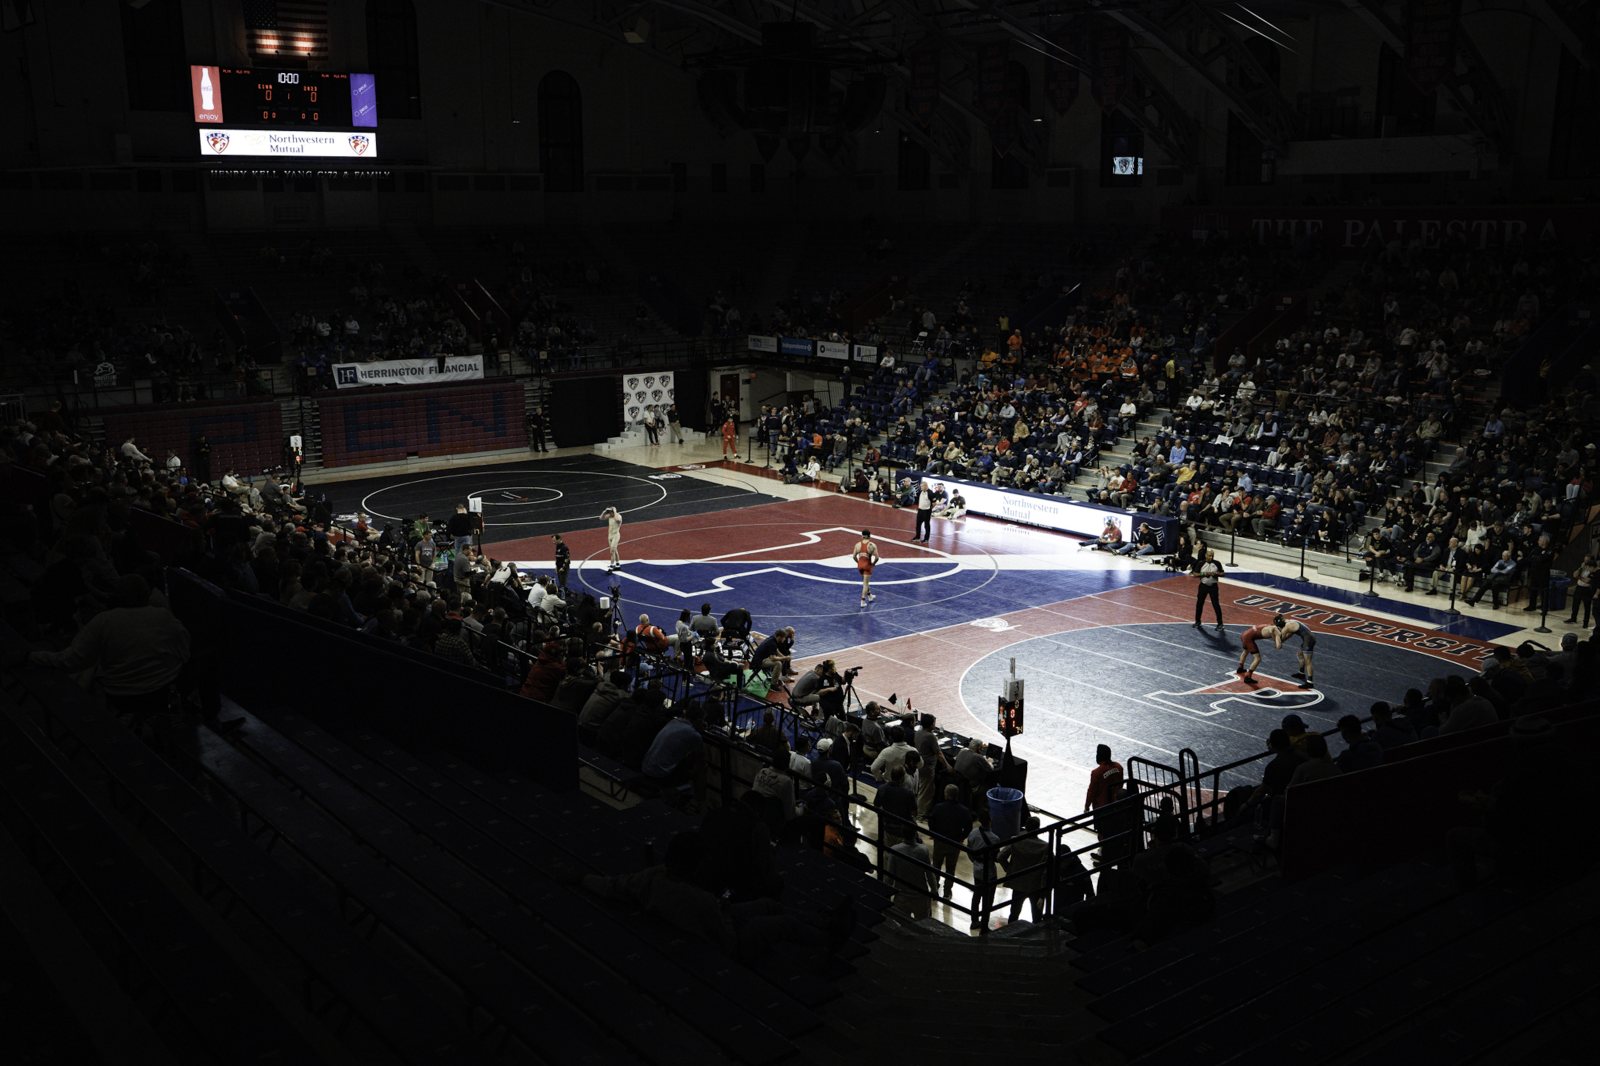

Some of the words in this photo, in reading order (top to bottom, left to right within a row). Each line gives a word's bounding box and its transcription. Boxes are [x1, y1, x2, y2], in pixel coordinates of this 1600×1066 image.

[278, 72, 299, 84] 10:00
[265, 90, 272, 101] 0
[310, 91, 317, 102] 0
[198, 112, 219, 120] enjoy
[269, 134, 335, 145] Northwestern
[270, 144, 304, 154] Mutual
[354, 170, 391, 179] FAMILY
[1251, 218, 1323, 247] THE
[360, 366, 425, 380] HERRINGTON
[428, 362, 480, 375] FIANCIAL
[1002, 495, 1060, 514] Northwestern
[1002, 506, 1031, 521] Mutual
